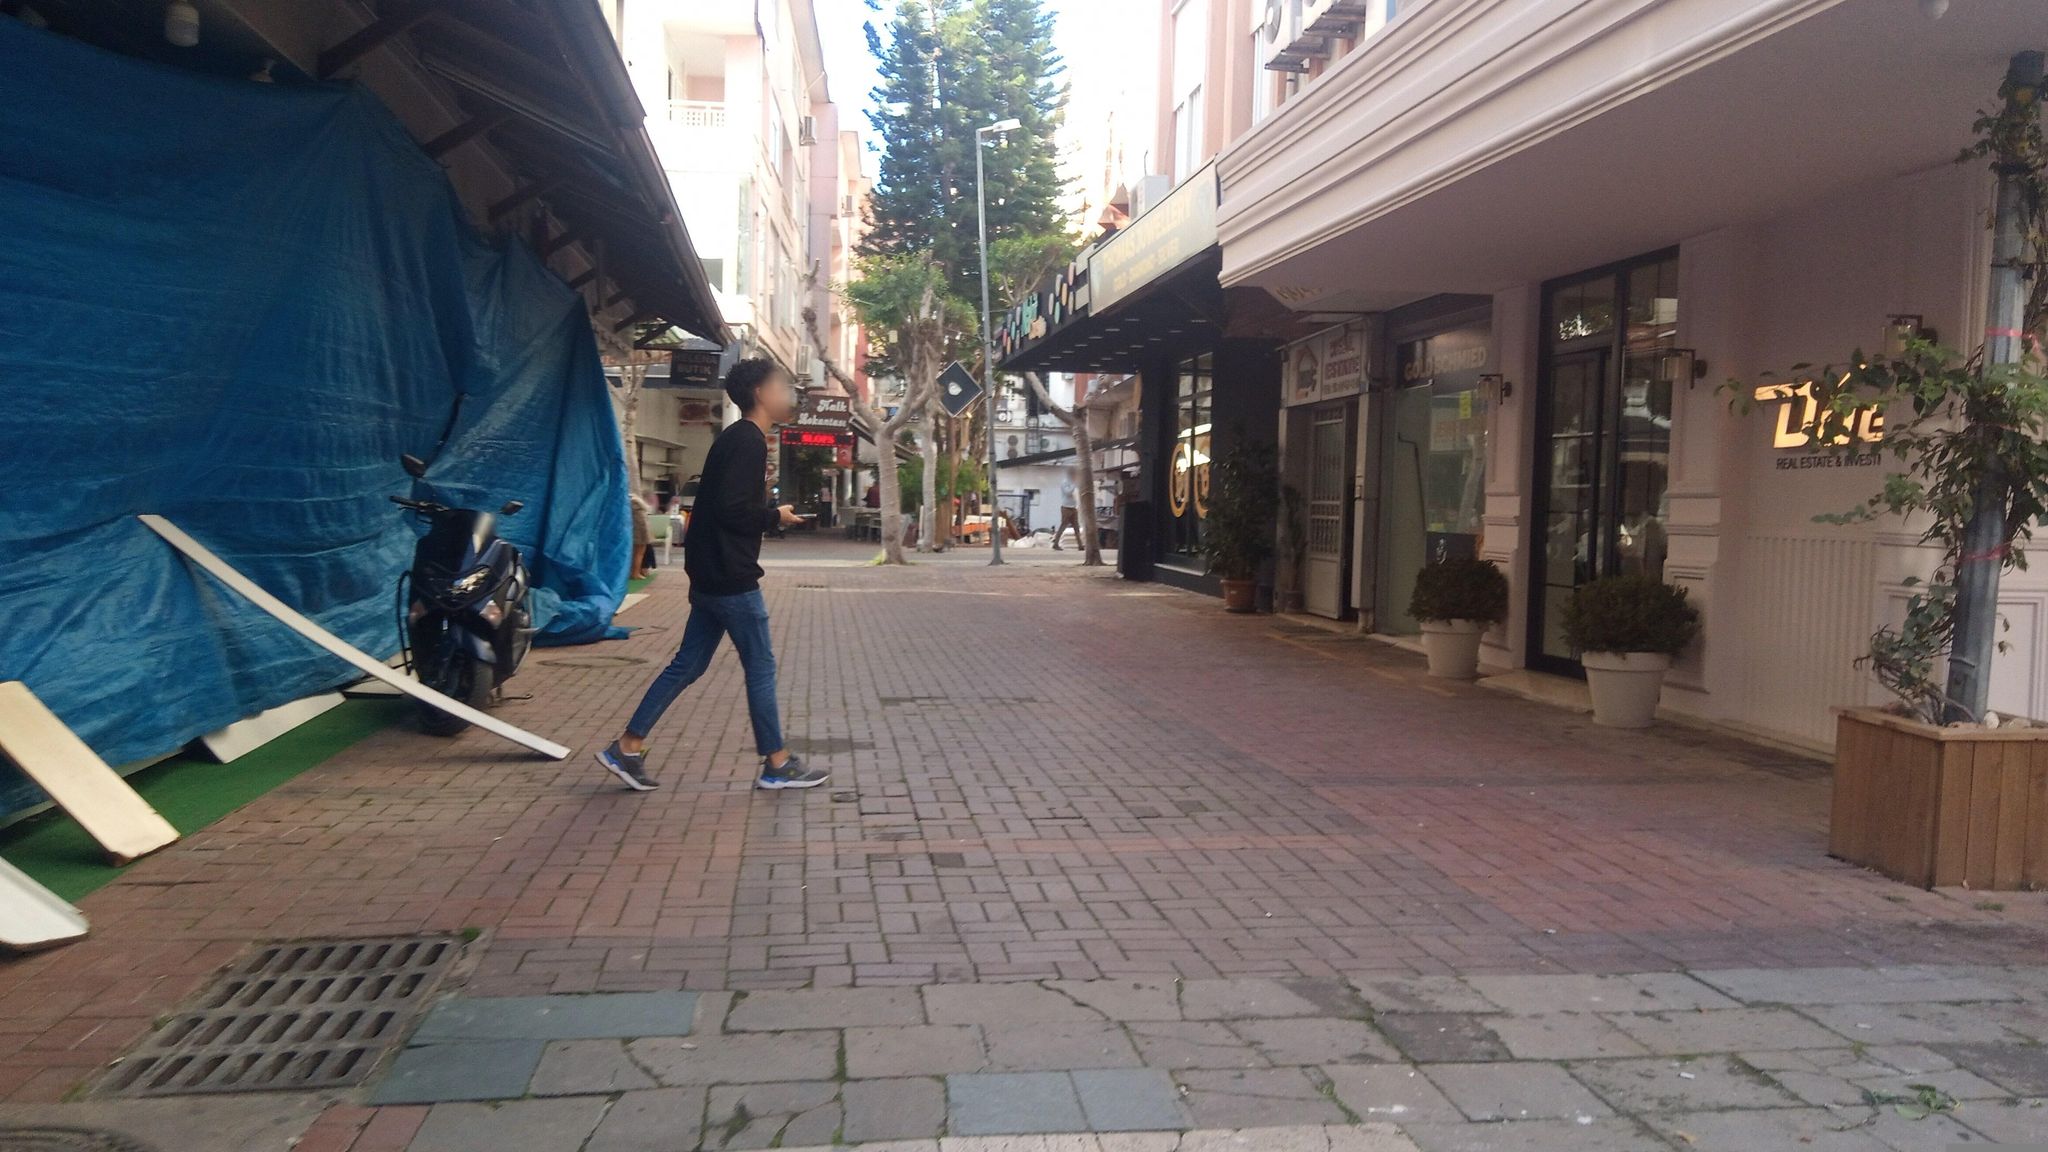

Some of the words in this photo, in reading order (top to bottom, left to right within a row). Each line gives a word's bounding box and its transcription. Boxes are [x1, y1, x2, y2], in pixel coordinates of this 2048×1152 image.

[1776, 457, 1799, 470] REAL
[1801, 455, 1834, 469] ESTATE
[1835, 455, 1842, 467] &
